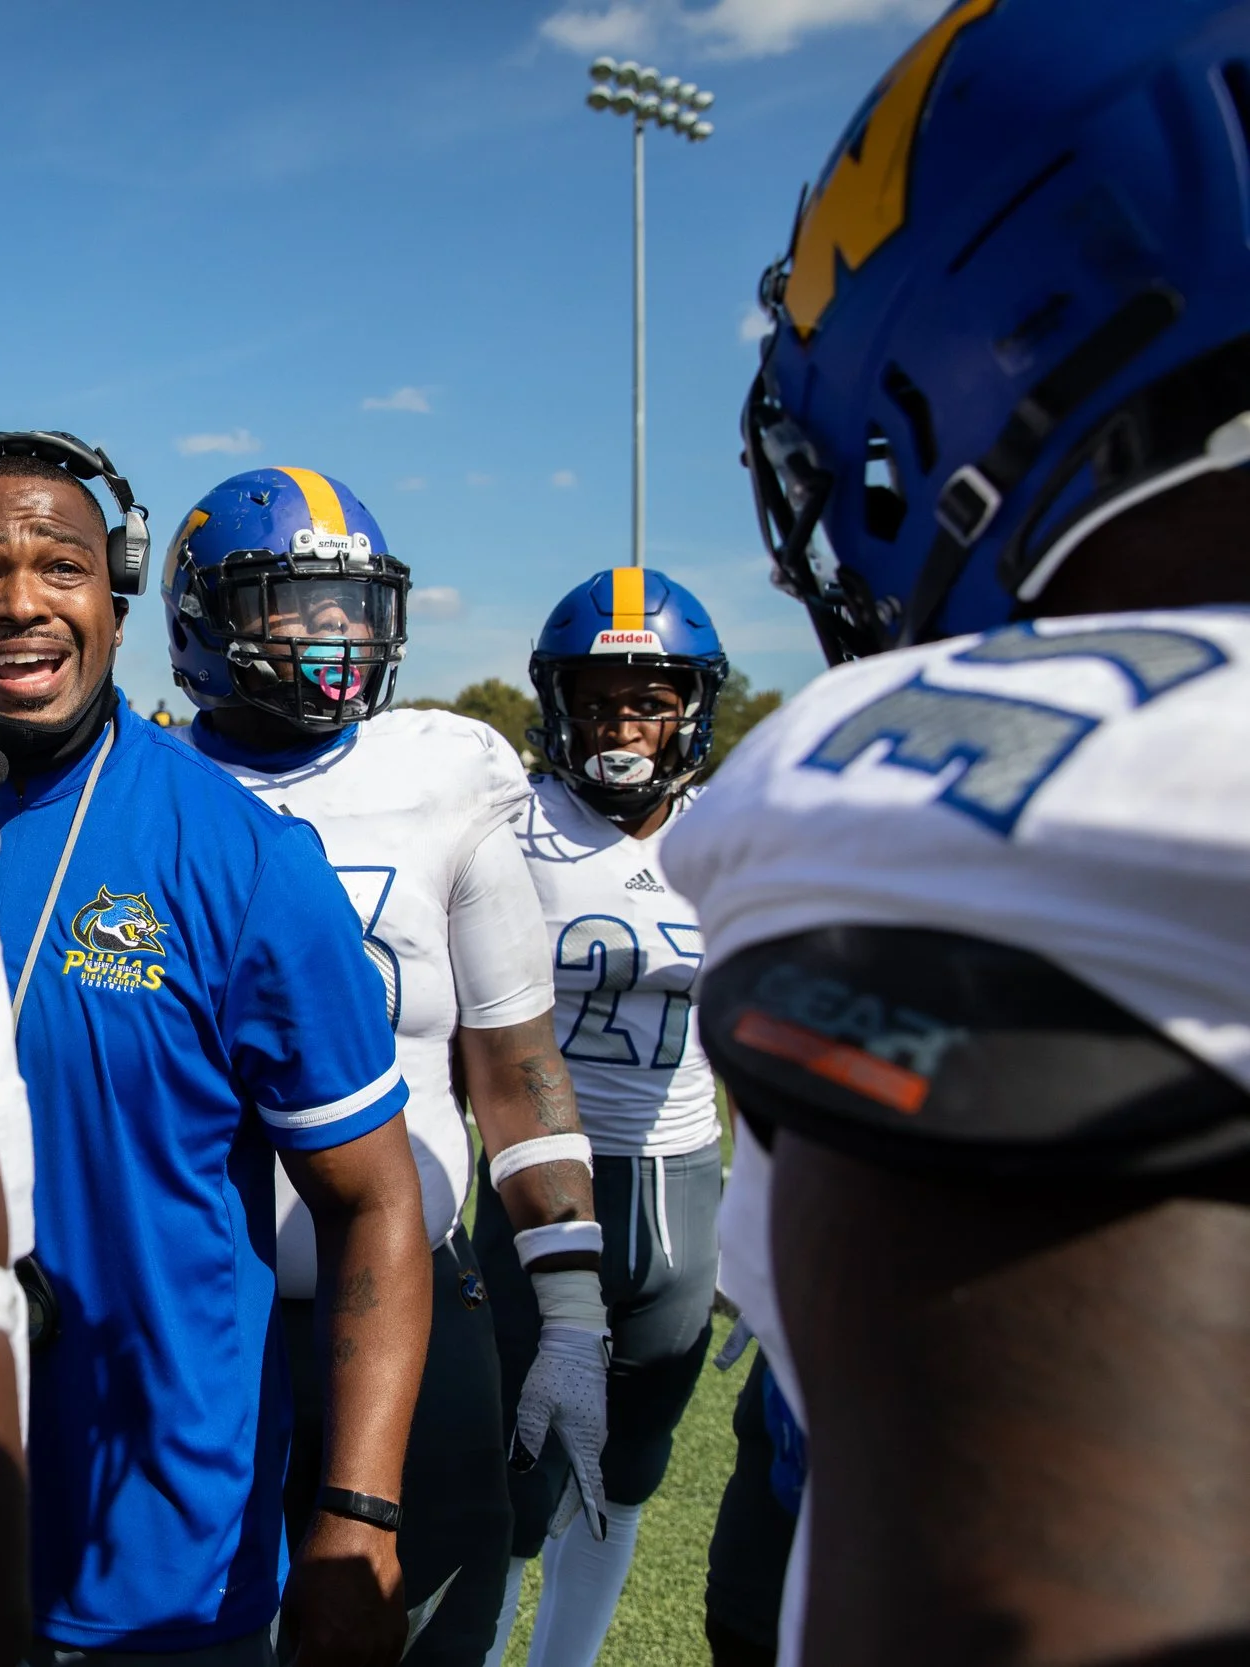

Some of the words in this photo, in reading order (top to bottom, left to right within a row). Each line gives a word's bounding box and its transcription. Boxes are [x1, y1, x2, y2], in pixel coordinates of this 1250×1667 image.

[318, 540, 348, 549] schutt
[601, 633, 653, 644] Riddell
[625, 881, 665, 893] adidas
[62, 950, 166, 991] PUMAS
[81, 971, 102, 982] HIGH
[107, 975, 140, 988] SCHOOL
[81, 979, 134, 994] FOOTBALL
[556, 913, 706, 1070] 27
